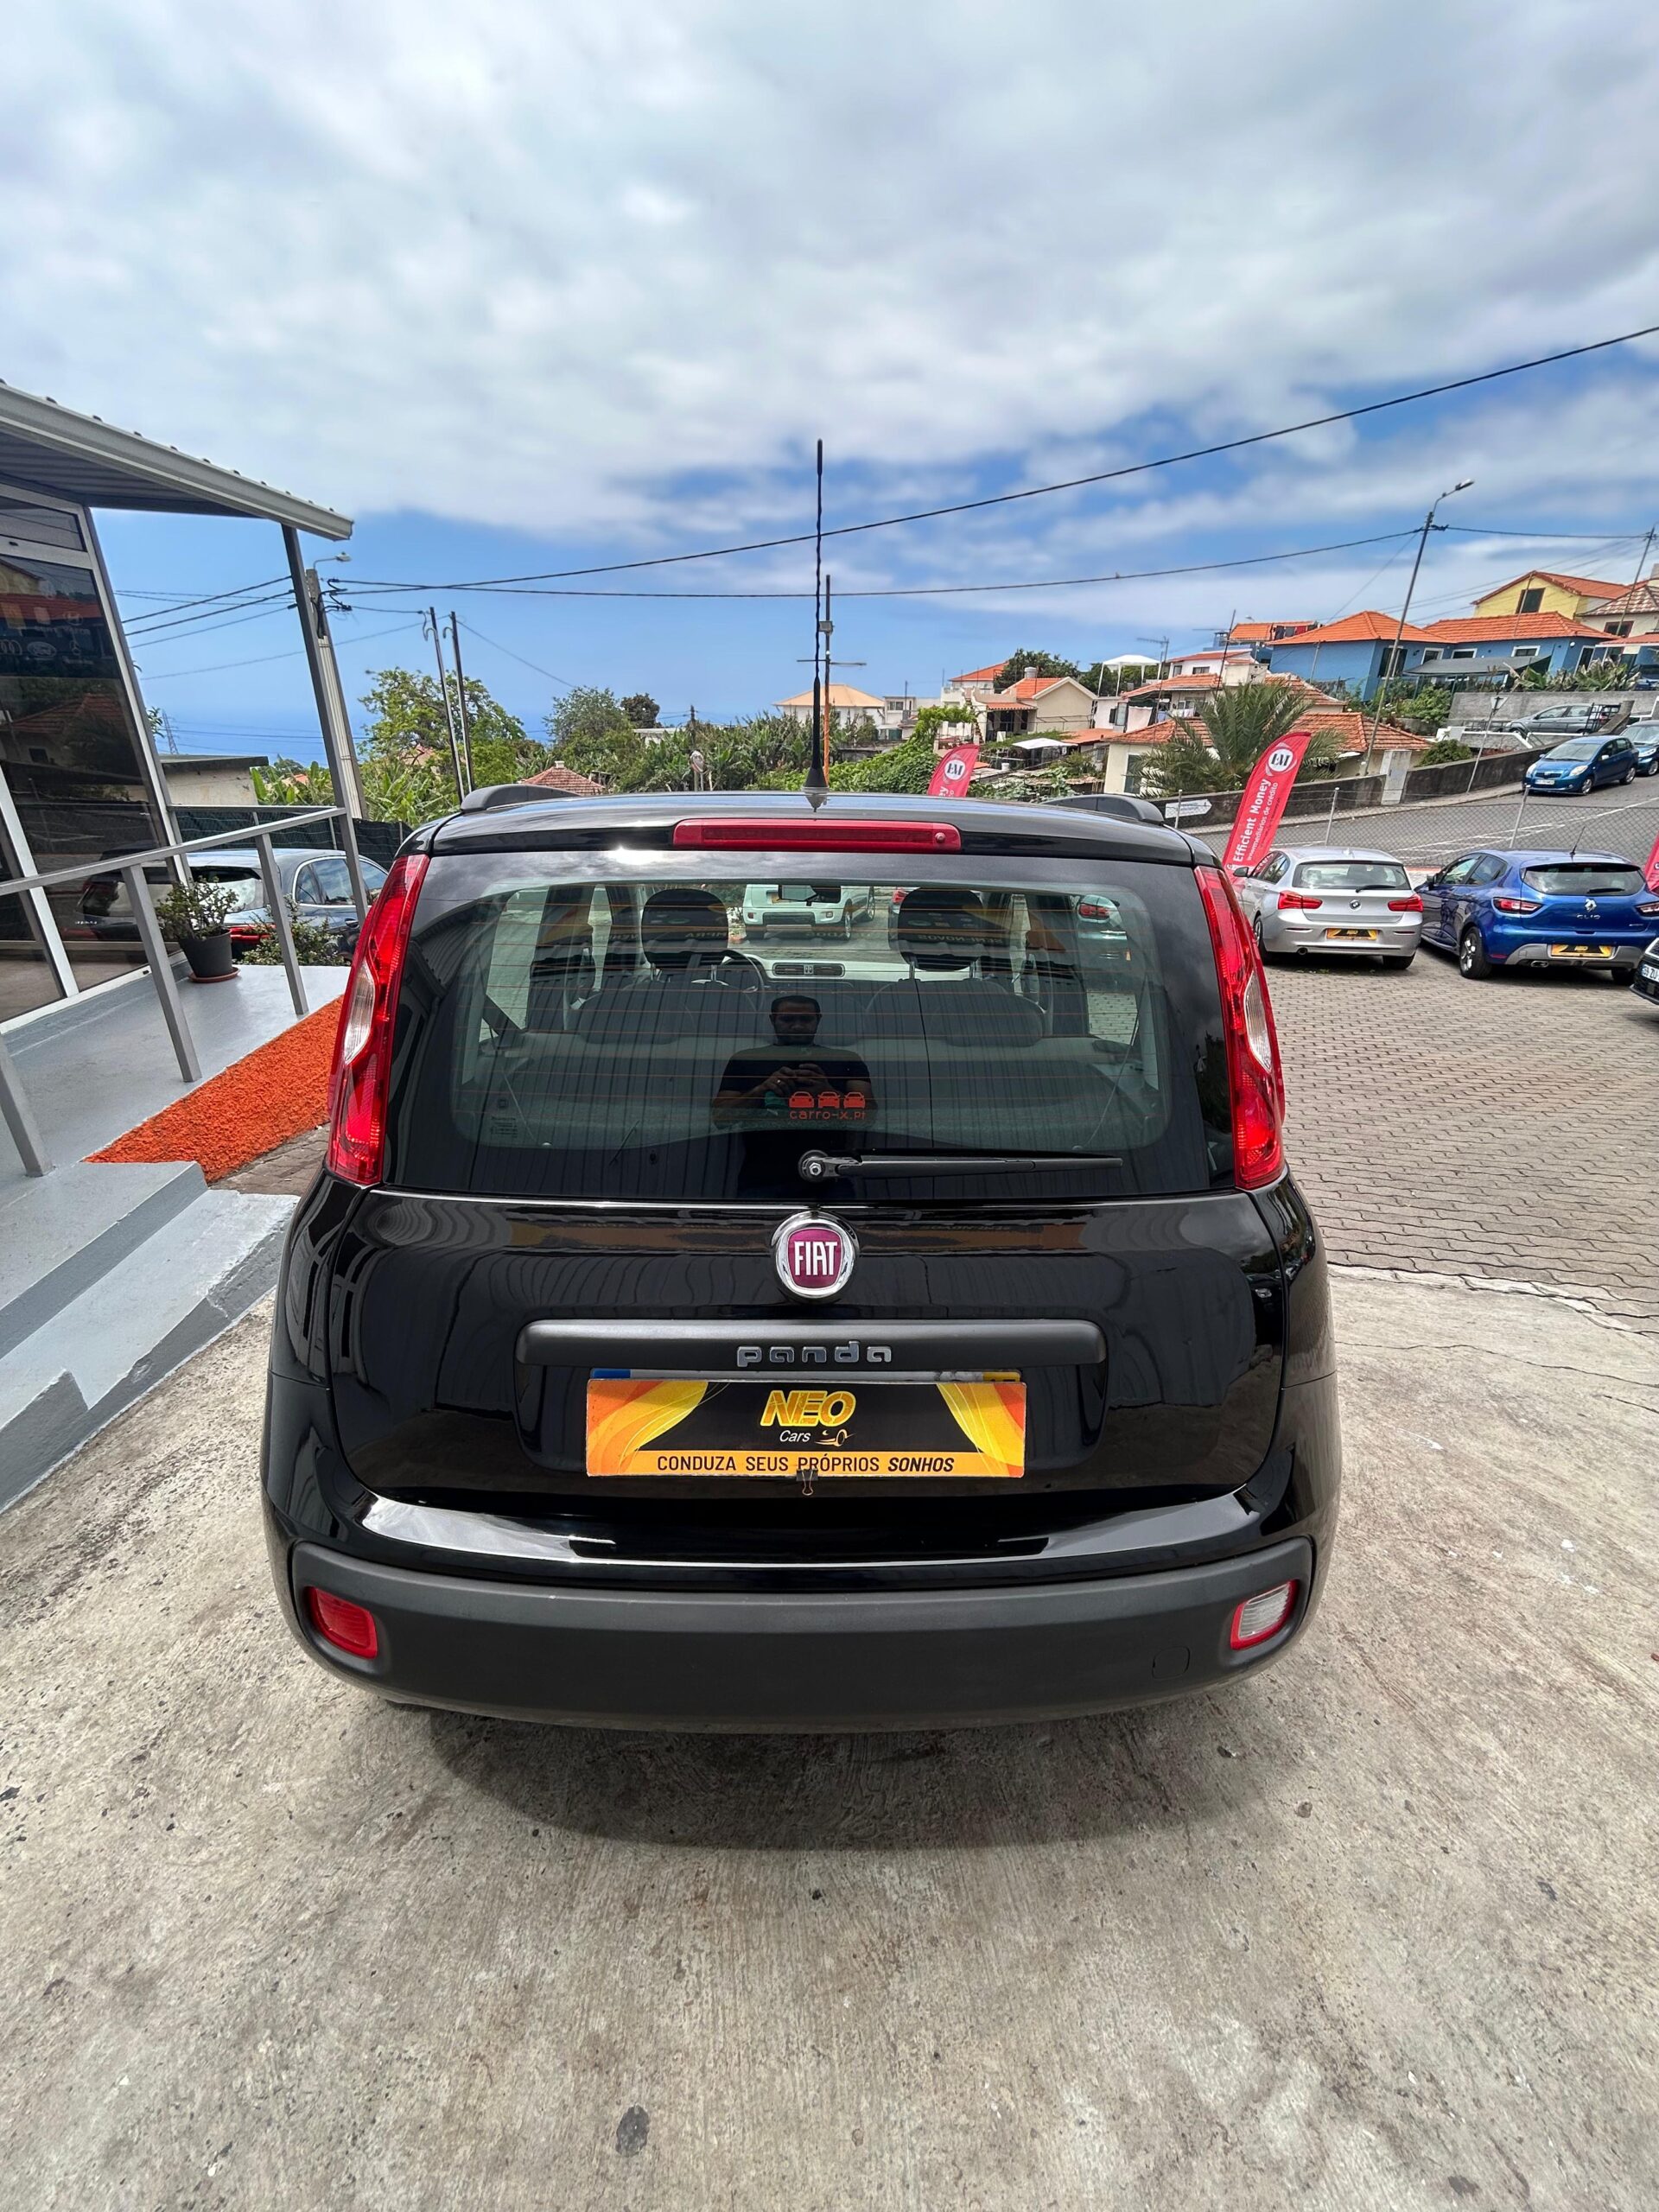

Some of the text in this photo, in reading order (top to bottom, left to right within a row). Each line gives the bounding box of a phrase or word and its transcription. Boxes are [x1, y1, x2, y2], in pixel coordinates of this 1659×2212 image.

[1263, 806, 1271, 816] de
[1267, 782, 1279, 805] crédito
[1233, 817, 1257, 862] Efficient
[1249, 779, 1272, 815] Money
[794, 1241, 837, 1276] FIAT
[737, 1341, 892, 1367] panda
[760, 1390, 856, 1427] NEO
[779, 1429, 810, 1442] Cars
[658, 1453, 955, 1471] CONDUZA SEUS PRÓPRIOS SONHOS
